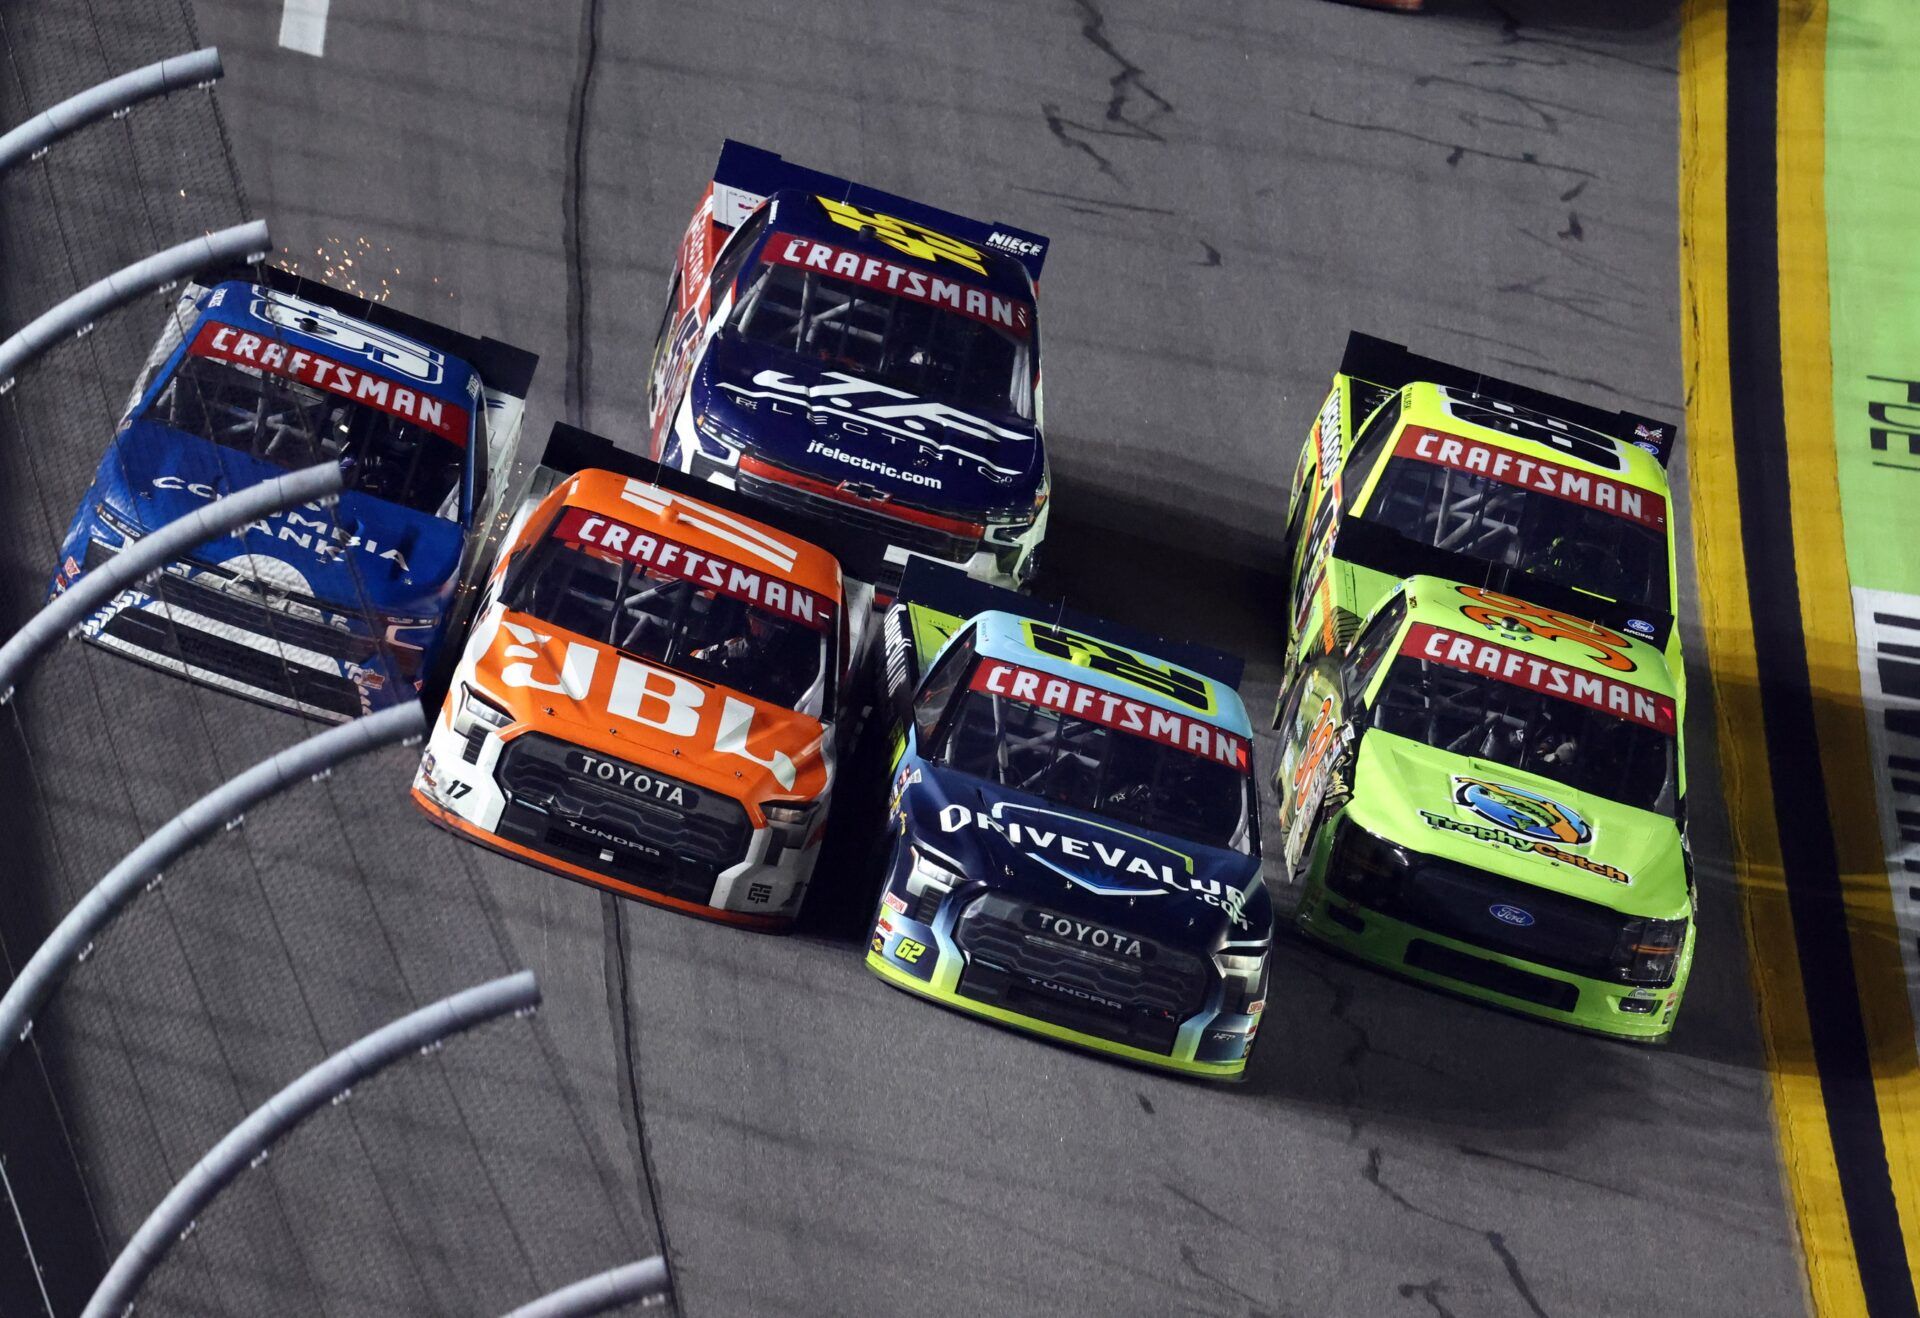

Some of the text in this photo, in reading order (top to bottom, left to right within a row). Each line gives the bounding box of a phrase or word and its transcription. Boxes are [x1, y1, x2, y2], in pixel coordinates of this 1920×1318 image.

[988, 231, 1044, 256] NIECE
[783, 240, 1014, 328] CRAFTSMAN
[211, 326, 443, 427] CRAFTSMAN
[806, 438, 943, 490] jfelectric.com
[1415, 433, 1641, 519] CRAFTSMAN
[577, 516, 813, 623] CRAFTSMAN
[1454, 584, 1638, 673] 38
[1623, 628, 1654, 640] RACING
[1424, 631, 1655, 724] CRAFTSMAN
[500, 640, 797, 793] JBL
[985, 664, 1239, 767] CRAFTSMAN
[446, 780, 473, 799] 17
[582, 755, 684, 806] TOYOTA
[567, 819, 660, 857] TUNDRA
[1419, 808, 1631, 885] TrophyCatch
[1039, 912, 1143, 959] TOYOTA
[1496, 905, 1526, 925] Ford
[895, 936, 927, 964] 62
[1027, 976, 1122, 1009] TUNDRA
